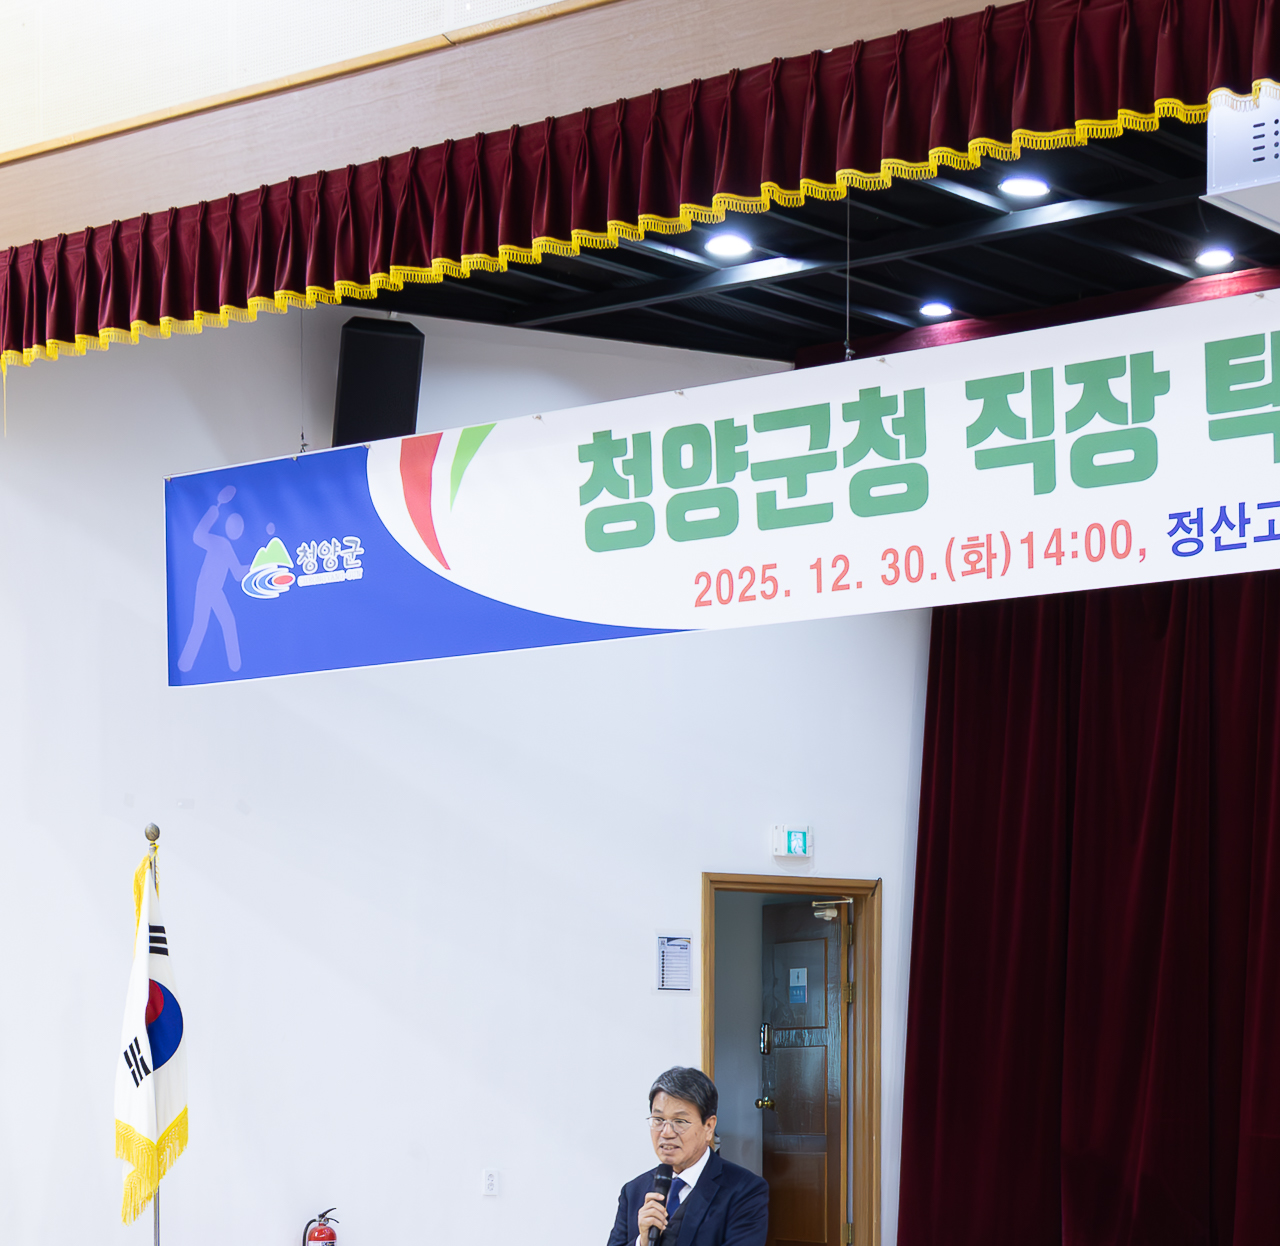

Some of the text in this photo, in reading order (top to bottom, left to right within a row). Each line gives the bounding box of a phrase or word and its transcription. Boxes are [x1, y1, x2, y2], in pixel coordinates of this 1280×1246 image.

[577, 386, 929, 553] 청양군청
[964, 350, 1170, 496] 직장
[296, 536, 365, 574] 청양군
[694, 562, 791, 608] 2025.
[809, 554, 863, 594] 12.
